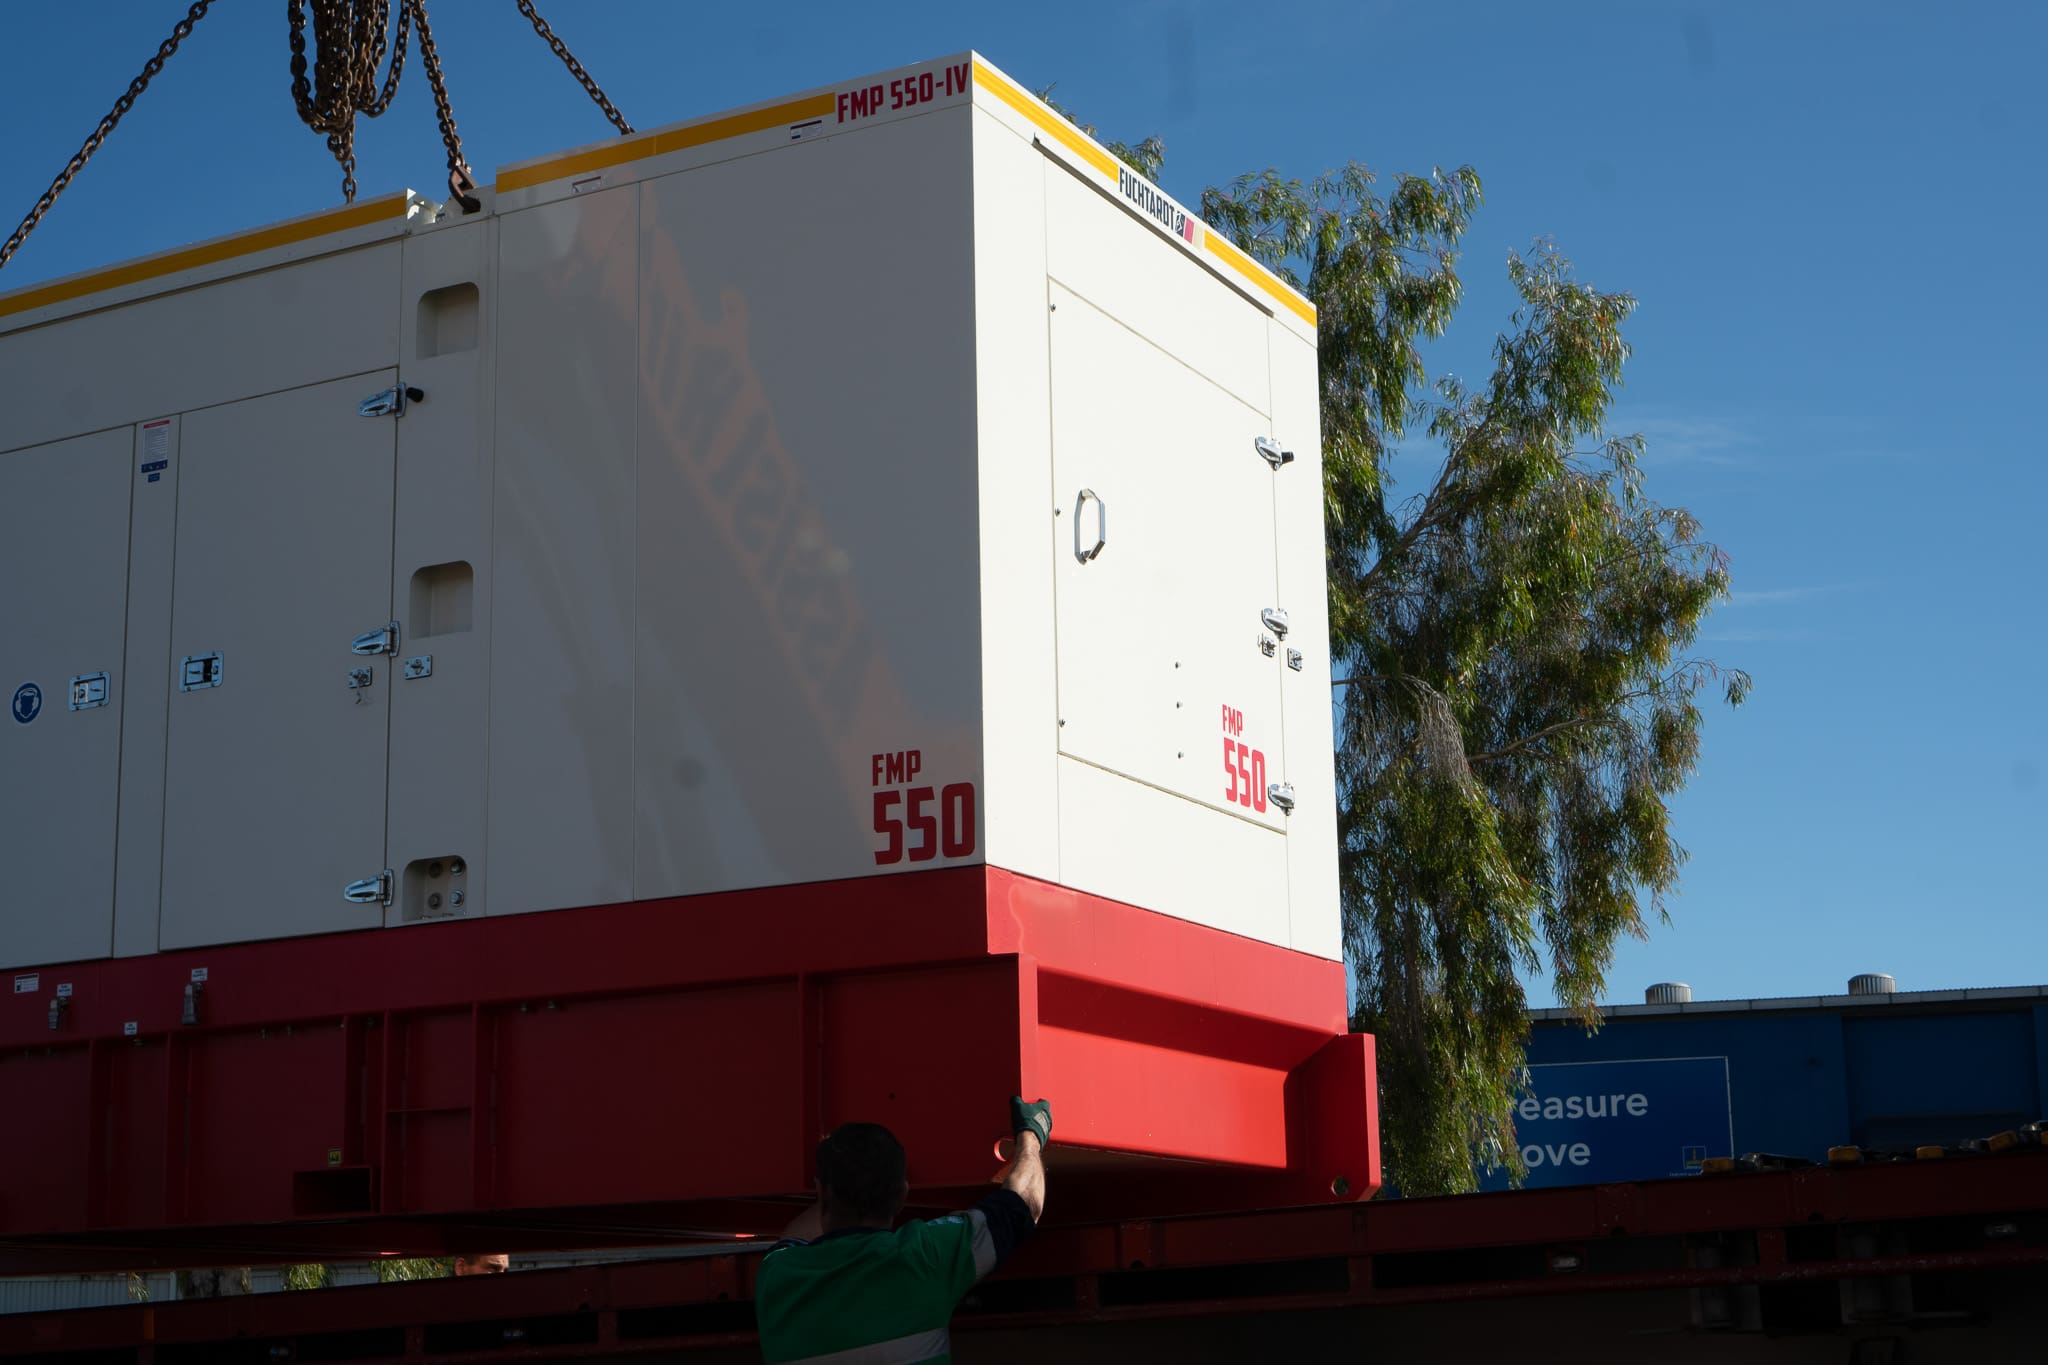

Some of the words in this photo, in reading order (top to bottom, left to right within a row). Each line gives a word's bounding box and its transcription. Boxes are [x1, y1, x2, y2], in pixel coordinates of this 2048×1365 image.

[838, 85, 883, 123] FMP
[890, 63, 969, 110] 550-IV
[1222, 704, 1243, 737] FMP
[872, 750, 921, 786] FMP
[1224, 737, 1266, 814] 550
[873, 782, 975, 865] 550
[1515, 1092, 1649, 1121] easure
[1516, 1142, 1592, 1169] ove
